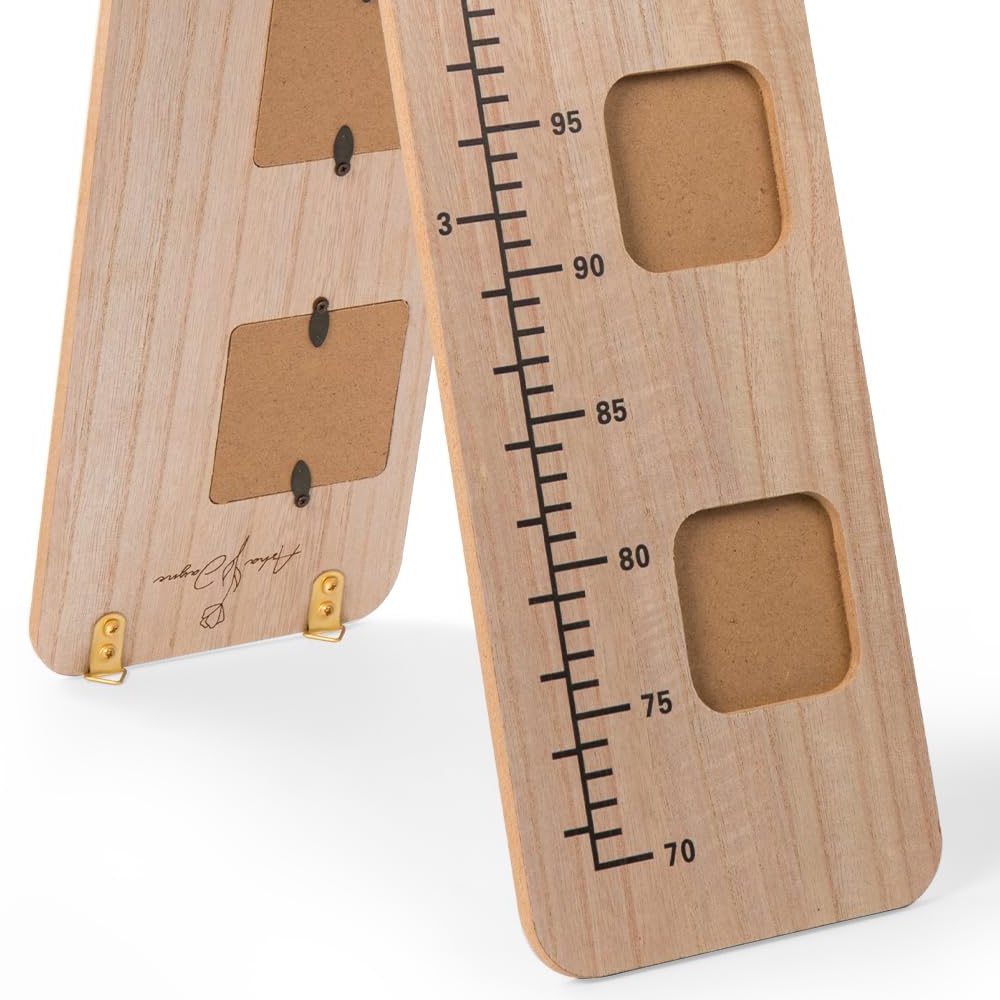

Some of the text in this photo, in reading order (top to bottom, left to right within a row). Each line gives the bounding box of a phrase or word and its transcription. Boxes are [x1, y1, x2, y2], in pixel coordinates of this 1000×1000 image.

[550, 110, 582, 136] 95
[436, 211, 453, 236] 3
[573, 253, 605, 280] 90
[595, 397, 627, 425] 85
[618, 543, 650, 571] 80
[640, 689, 673, 718] 75
[663, 838, 696, 867] 70
